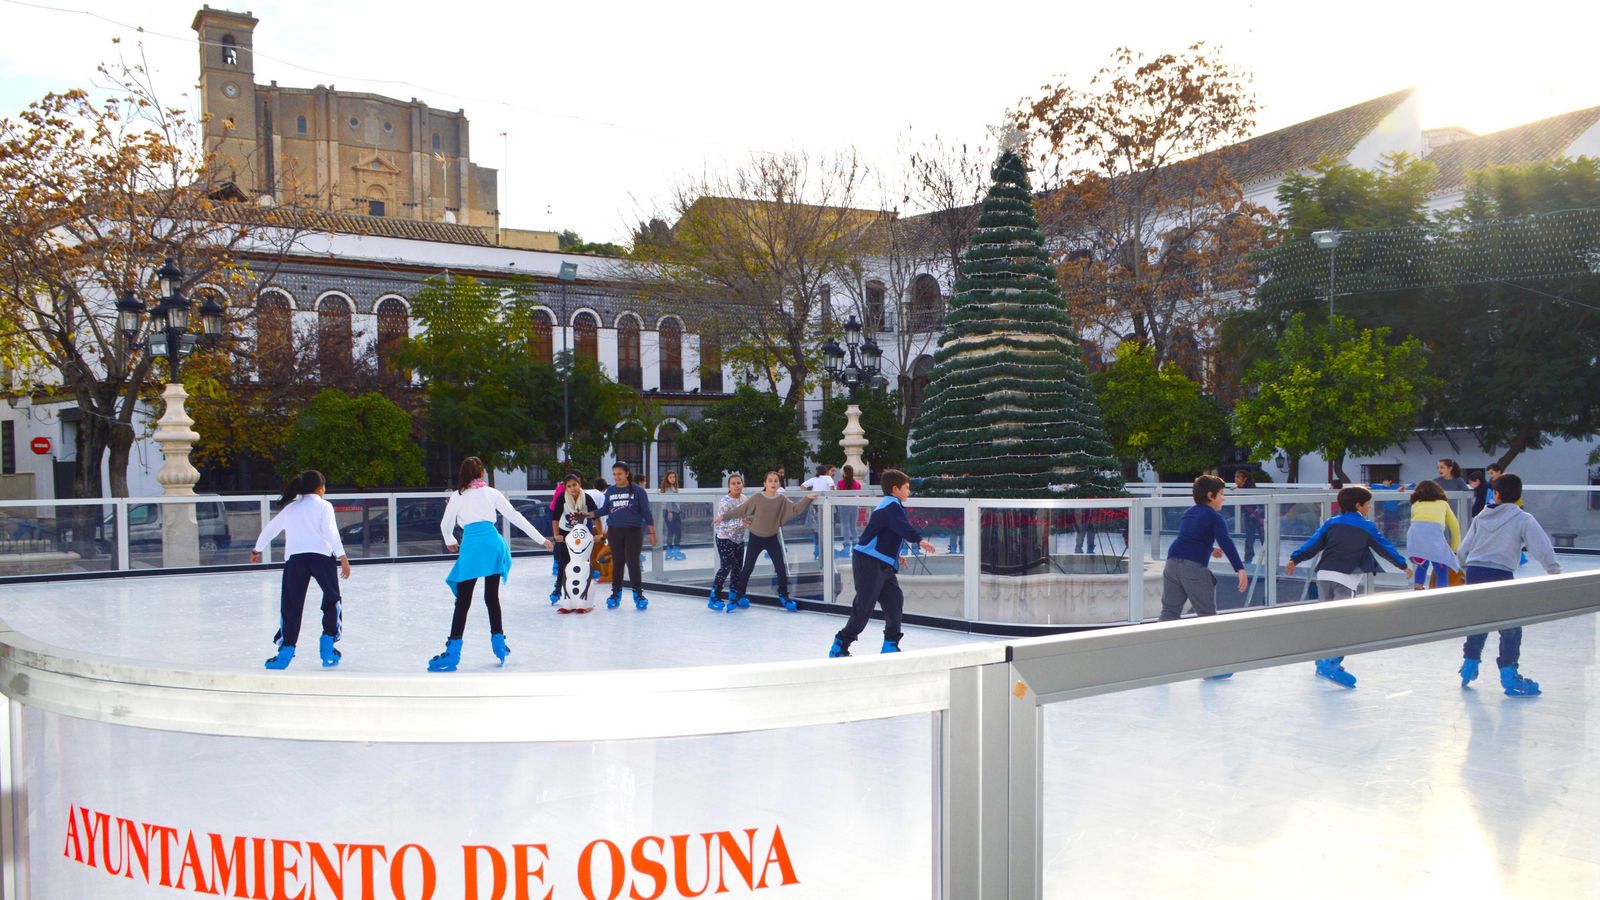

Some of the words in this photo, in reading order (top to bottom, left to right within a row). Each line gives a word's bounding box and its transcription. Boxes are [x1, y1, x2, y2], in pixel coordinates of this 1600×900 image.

[63, 802, 437, 900] AYUNTAMIENTO
[462, 844, 553, 900] DE
[577, 824, 801, 900] OSUNA
